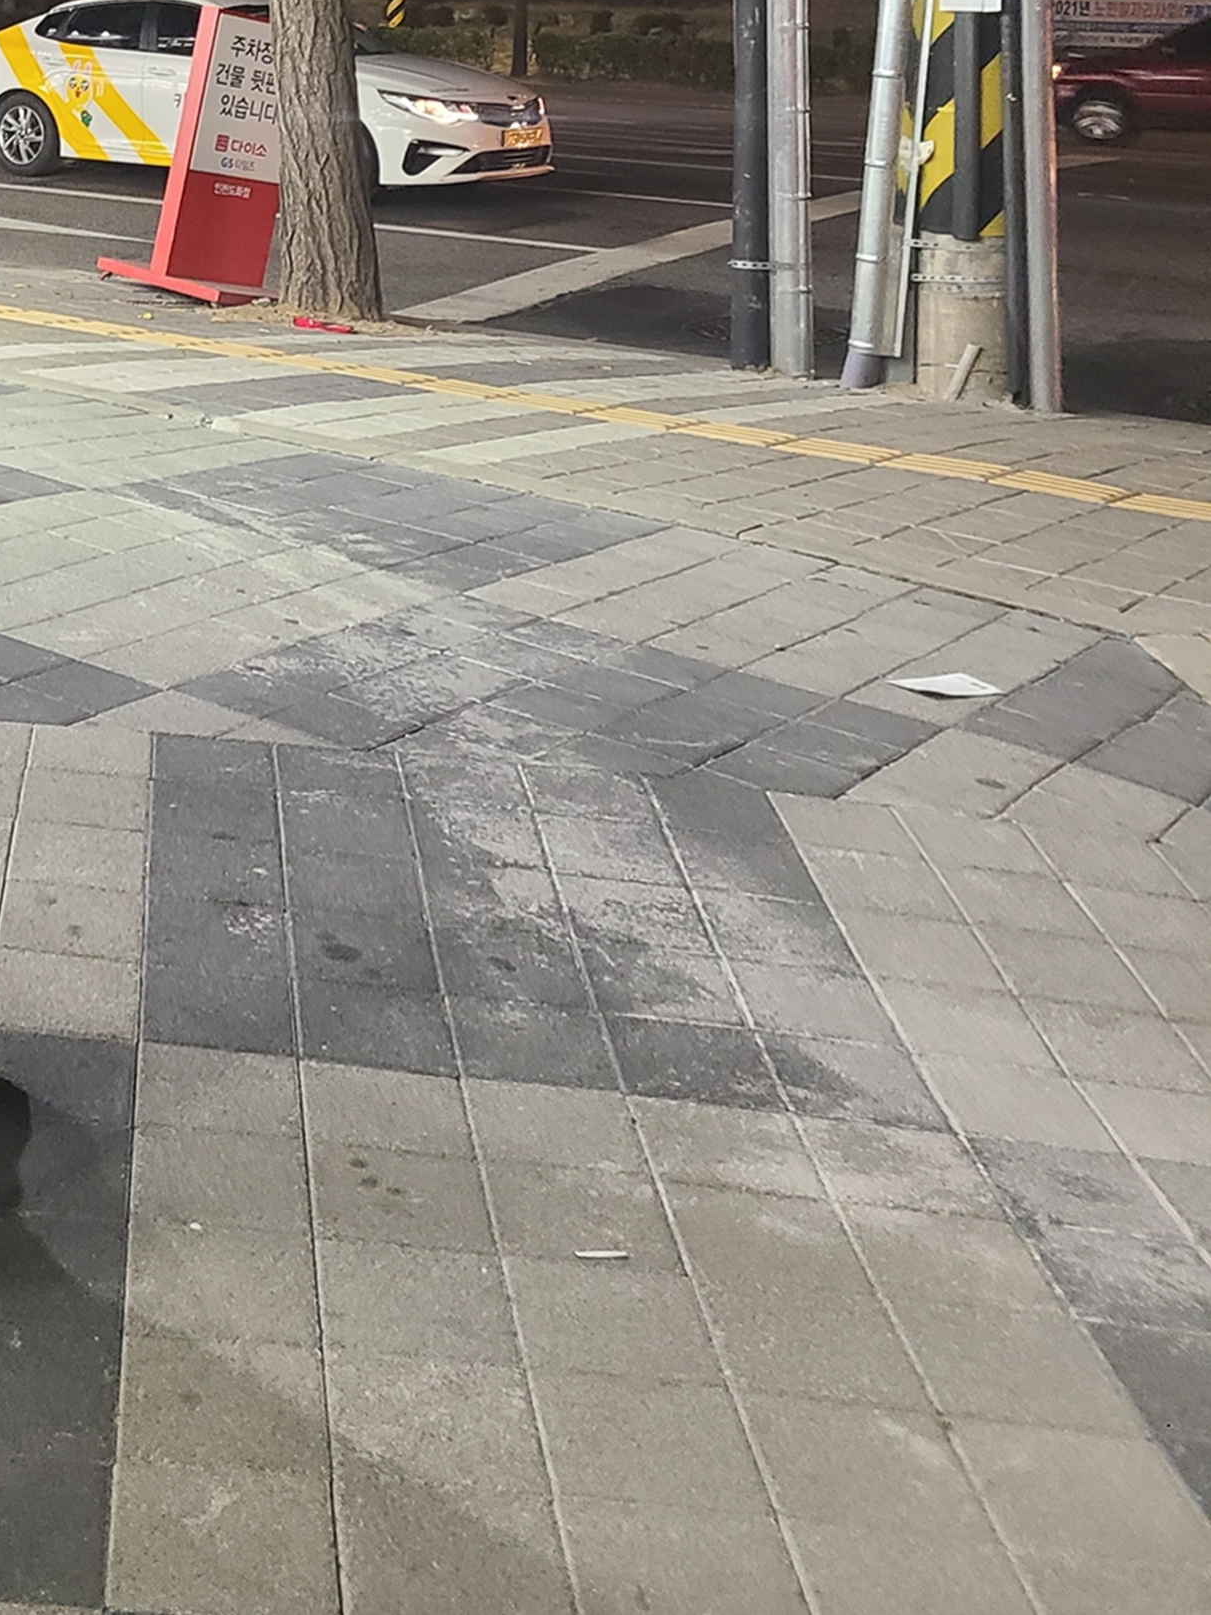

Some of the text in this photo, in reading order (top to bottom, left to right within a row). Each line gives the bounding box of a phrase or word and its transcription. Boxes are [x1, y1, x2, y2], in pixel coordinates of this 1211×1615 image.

[1051, 0, 1091, 17] 021년
[216, 63, 246, 89] 건물
[219, 94, 278, 125] 있습니다
[230, 139, 268, 157] 다이소
